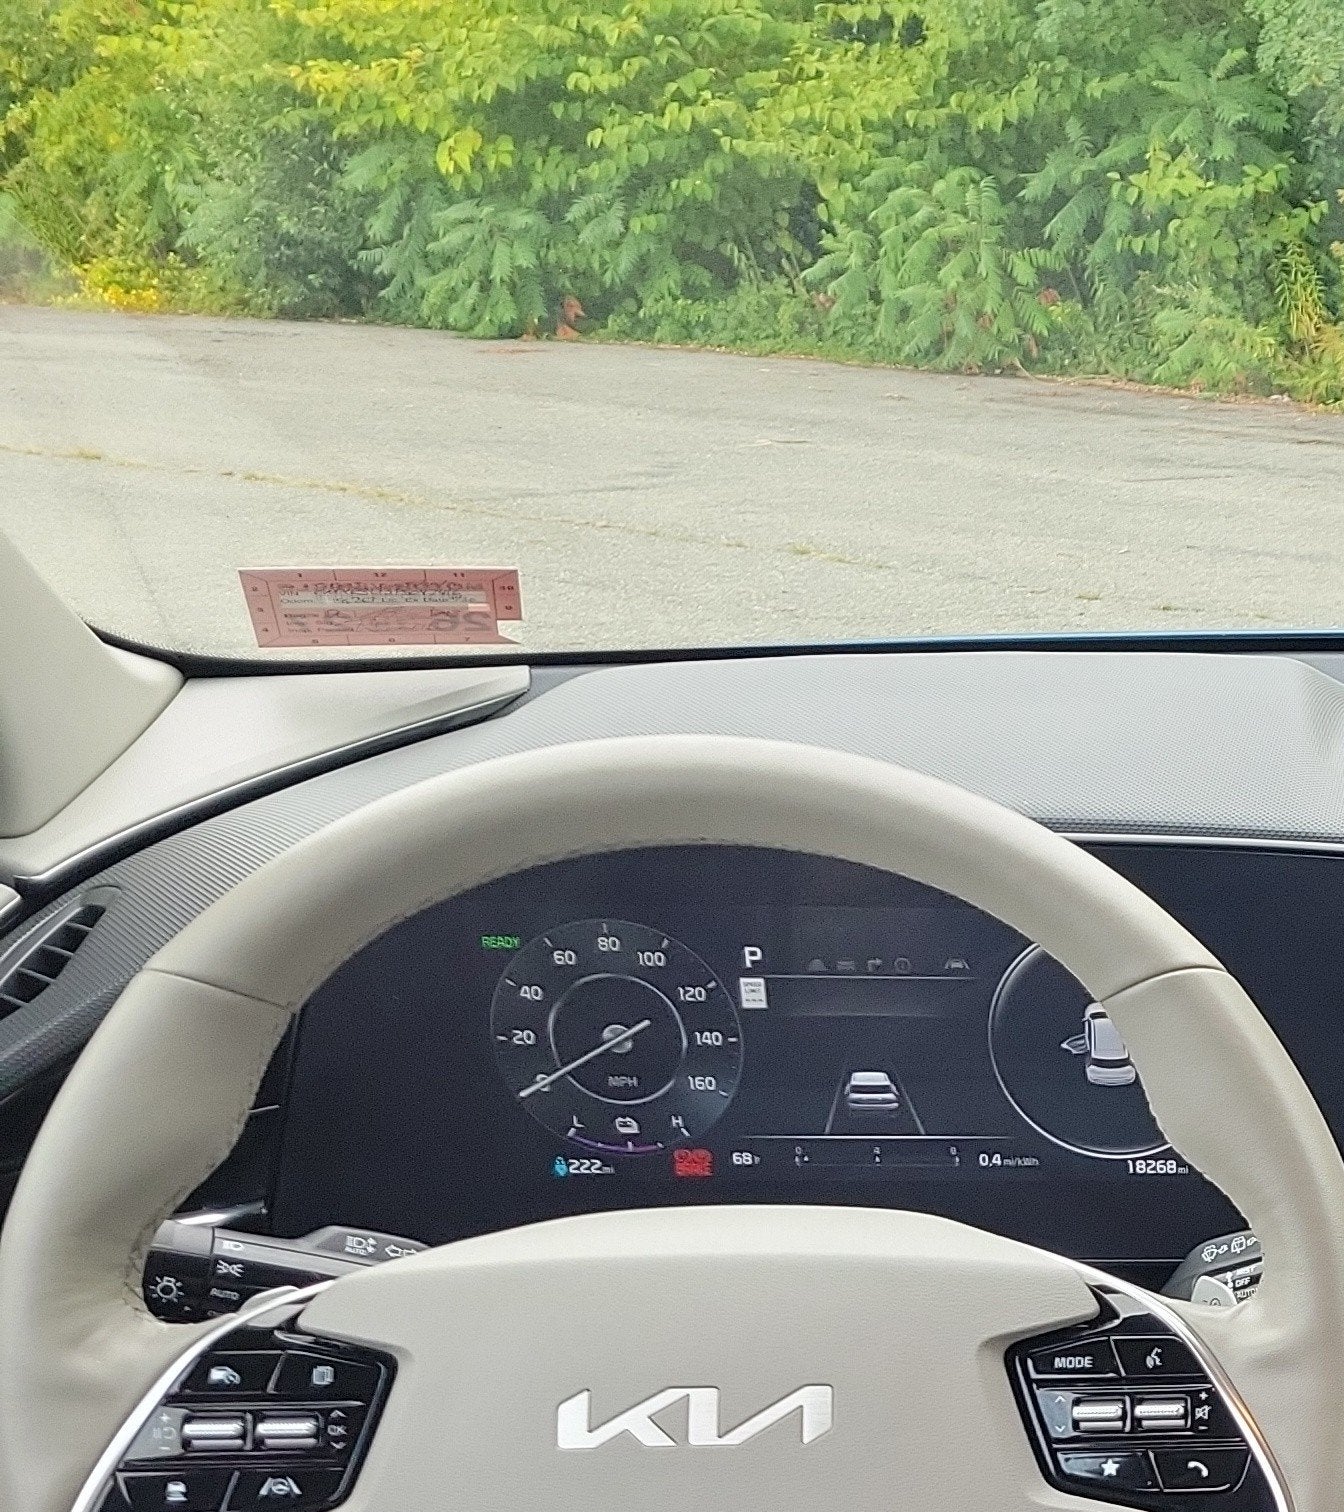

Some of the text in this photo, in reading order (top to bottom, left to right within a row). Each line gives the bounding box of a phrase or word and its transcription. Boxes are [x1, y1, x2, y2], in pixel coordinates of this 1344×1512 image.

[598, 936, 620, 950] 80
[554, 951, 576, 965] 60
[637, 951, 666, 967] 100
[744, 947, 761, 968] P
[519, 985, 543, 1000] 40
[678, 986, 706, 1001] 120
[511, 1030, 536, 1045] 20
[696, 1031, 722, 1046] 140
[689, 1075, 716, 1090] 160
[1054, 1356, 1094, 1369] MODE
